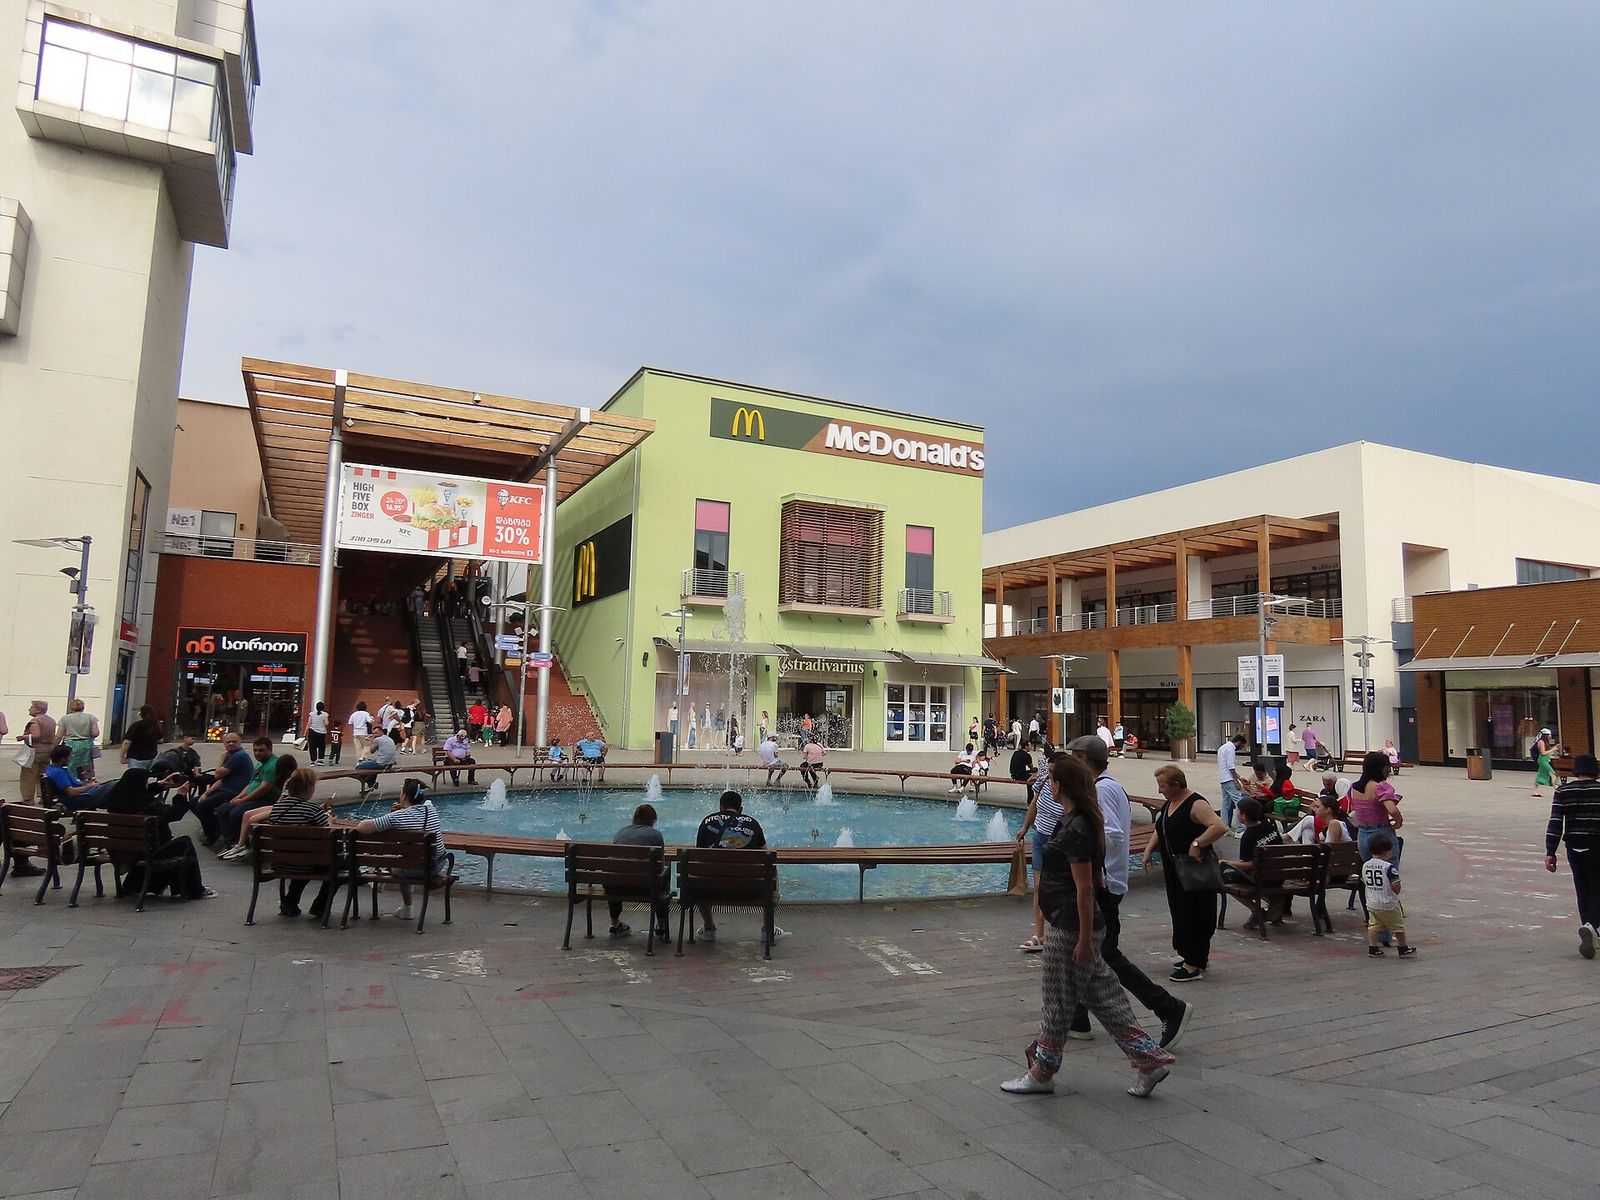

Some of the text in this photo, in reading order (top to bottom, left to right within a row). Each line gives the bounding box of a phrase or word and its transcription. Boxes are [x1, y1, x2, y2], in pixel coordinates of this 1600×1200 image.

[825, 423, 985, 471] McDonald's
[353, 482, 374, 492] HIGH
[352, 492, 371, 501] FIVE
[509, 496, 532, 505] KFC
[351, 502, 369, 511] BOX
[351, 511, 375, 519] ZINGER
[399, 528, 412, 536] KFC
[494, 526, 530, 545] 30%
[185, 635, 215, 654] ინ
[1365, 870, 1383, 886] 36
